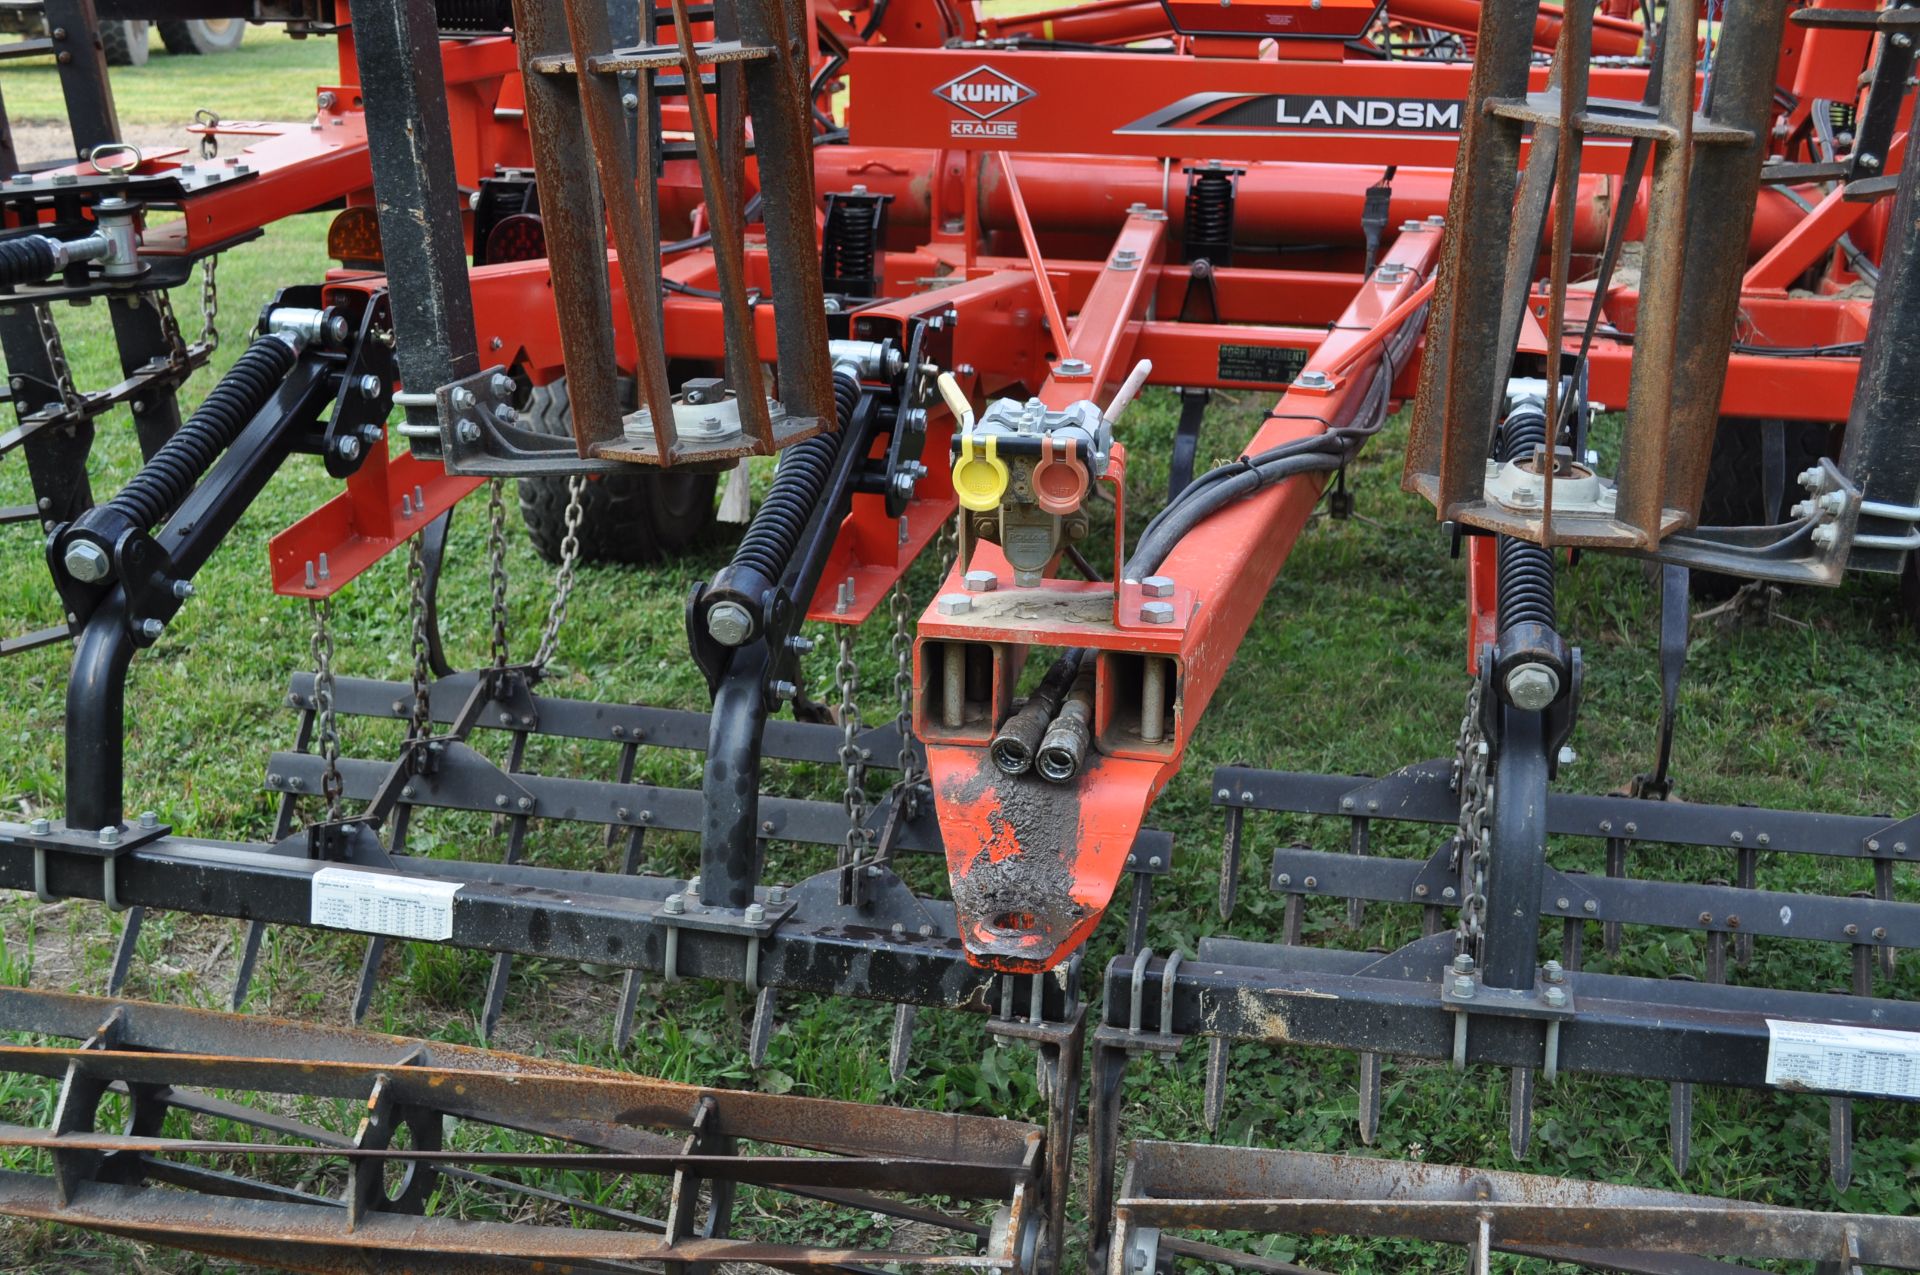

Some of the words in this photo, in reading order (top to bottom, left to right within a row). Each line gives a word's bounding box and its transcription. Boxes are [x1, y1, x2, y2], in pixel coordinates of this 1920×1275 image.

[950, 83, 1018, 103] KUHN
[1276, 98, 1463, 129] LANDSM
[950, 123, 1018, 136] KRAUSE
